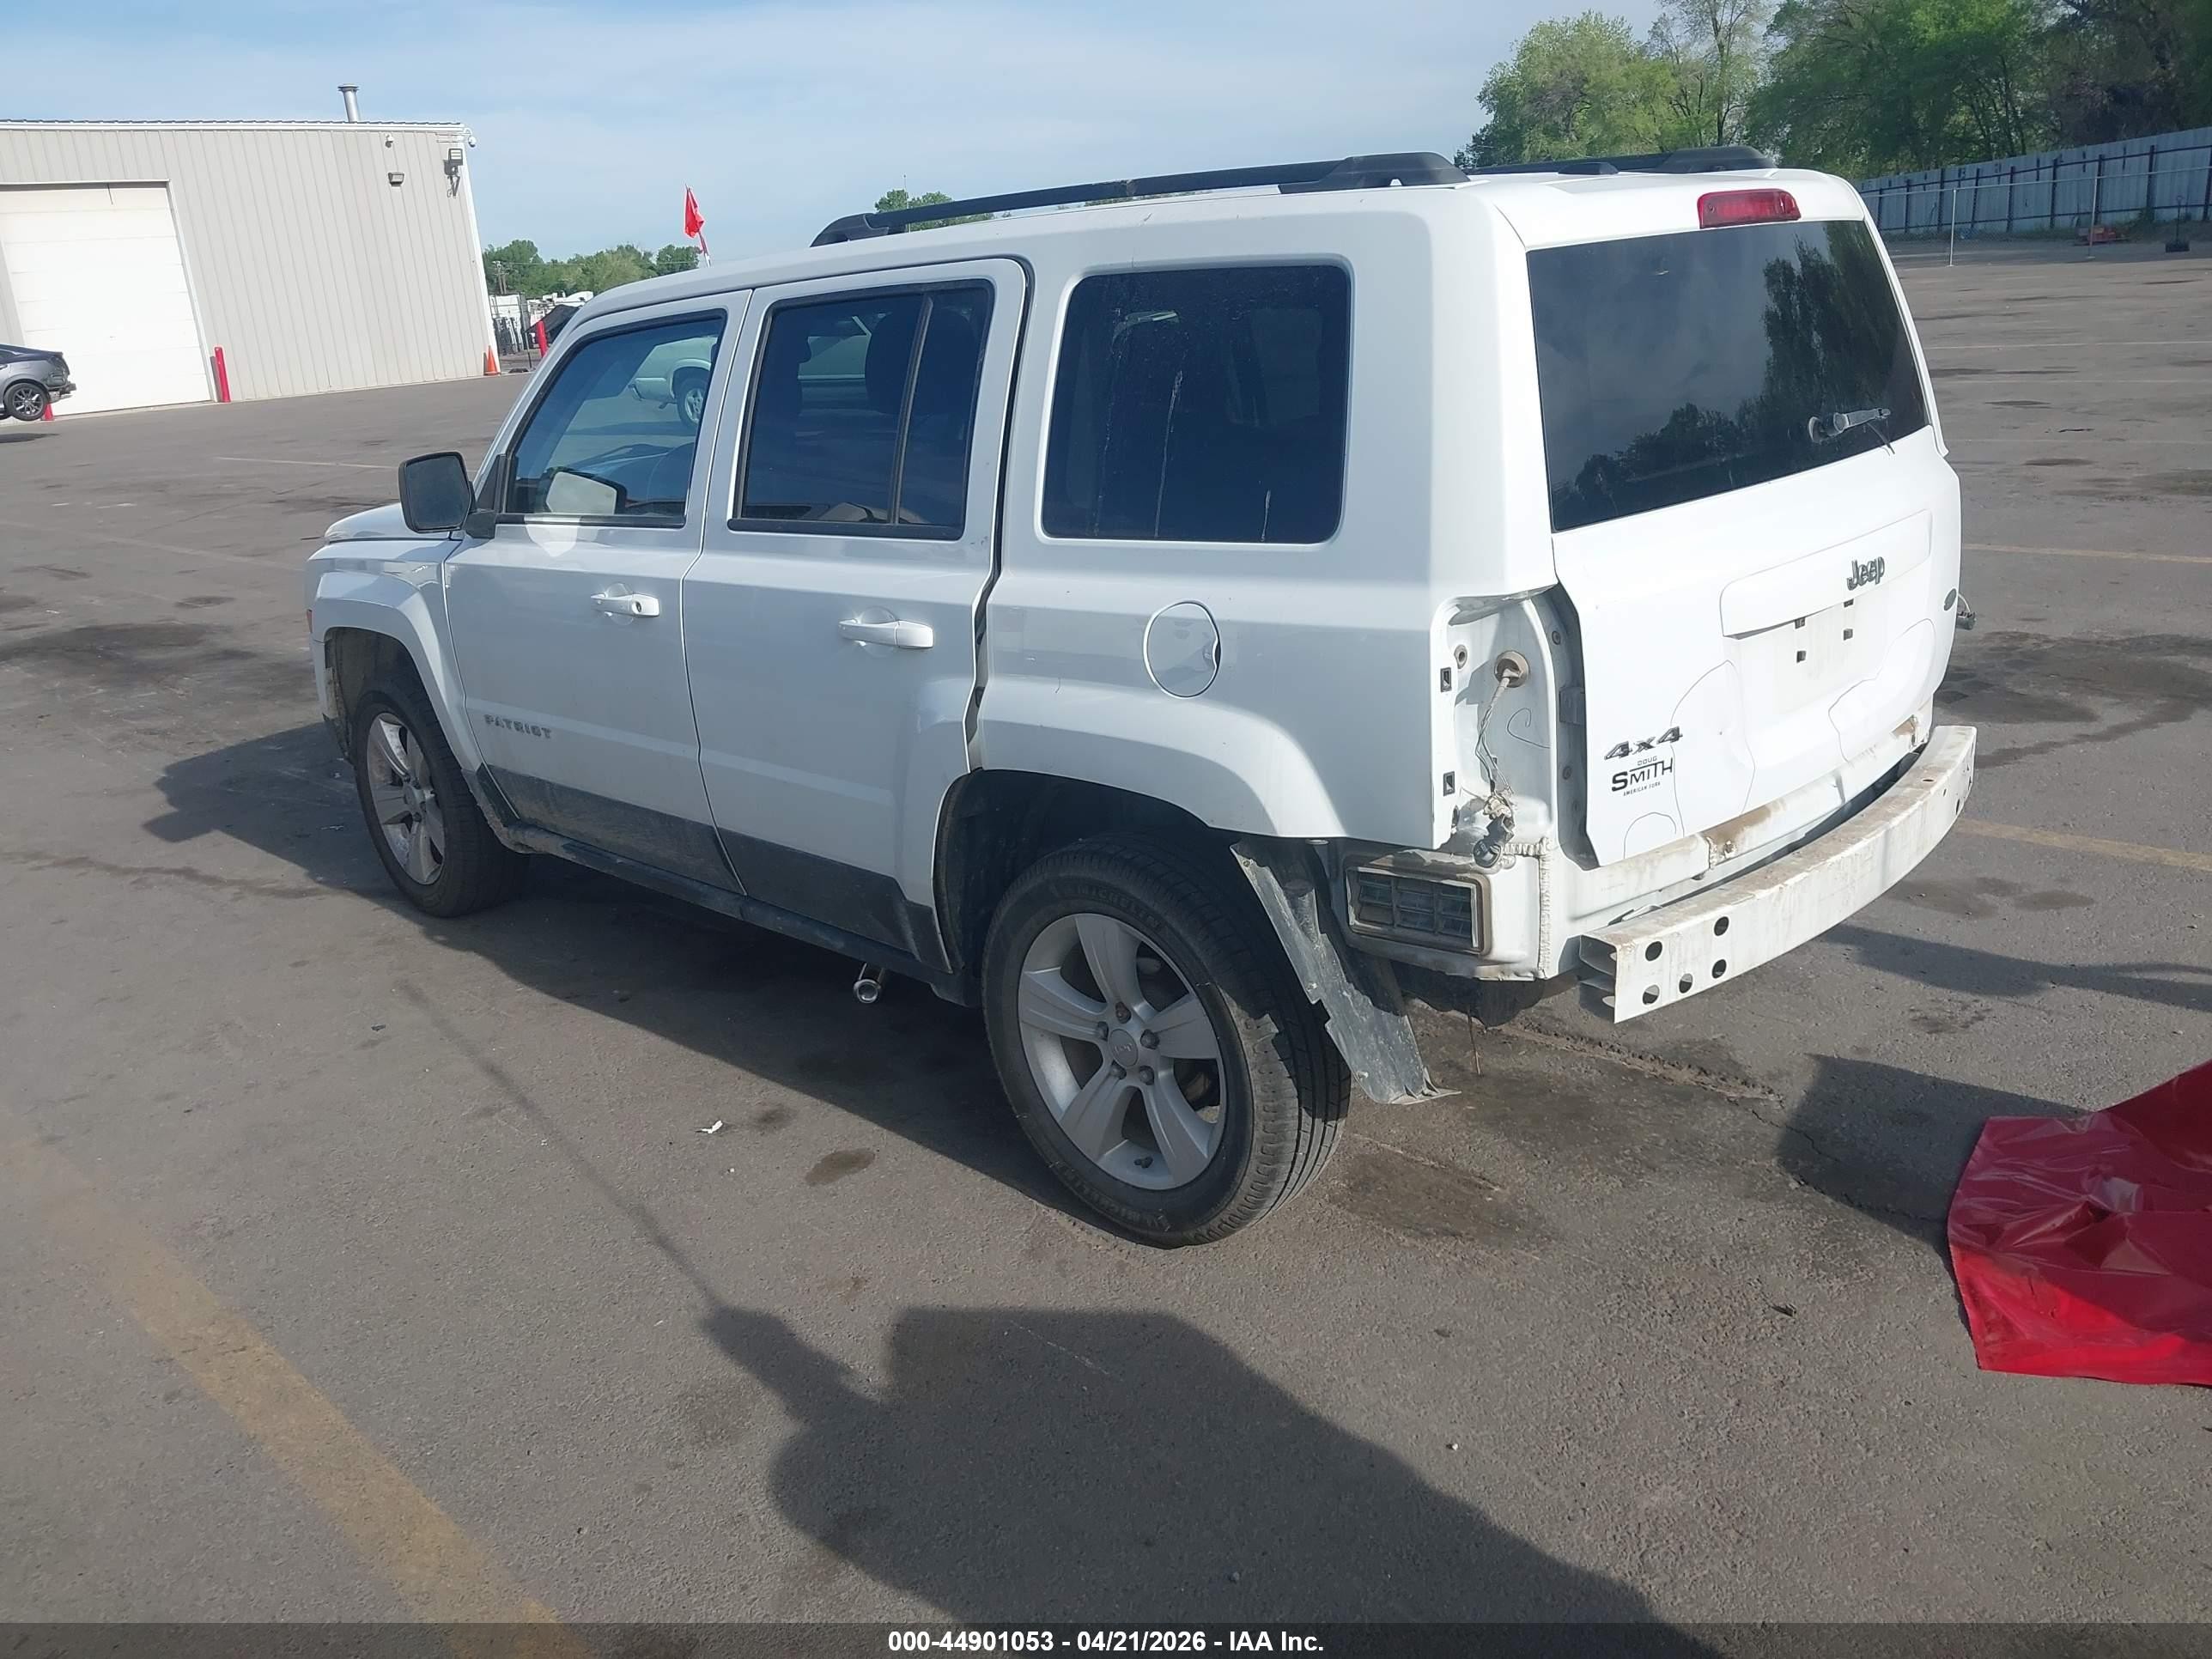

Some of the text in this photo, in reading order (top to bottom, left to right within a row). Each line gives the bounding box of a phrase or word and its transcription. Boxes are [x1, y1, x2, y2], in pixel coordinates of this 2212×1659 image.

[1846, 556, 1886, 591] Jeep
[483, 714, 552, 739] PATRIOT
[1611, 757, 1674, 792] SMITH
[1637, 755, 1657, 766] DOUG
